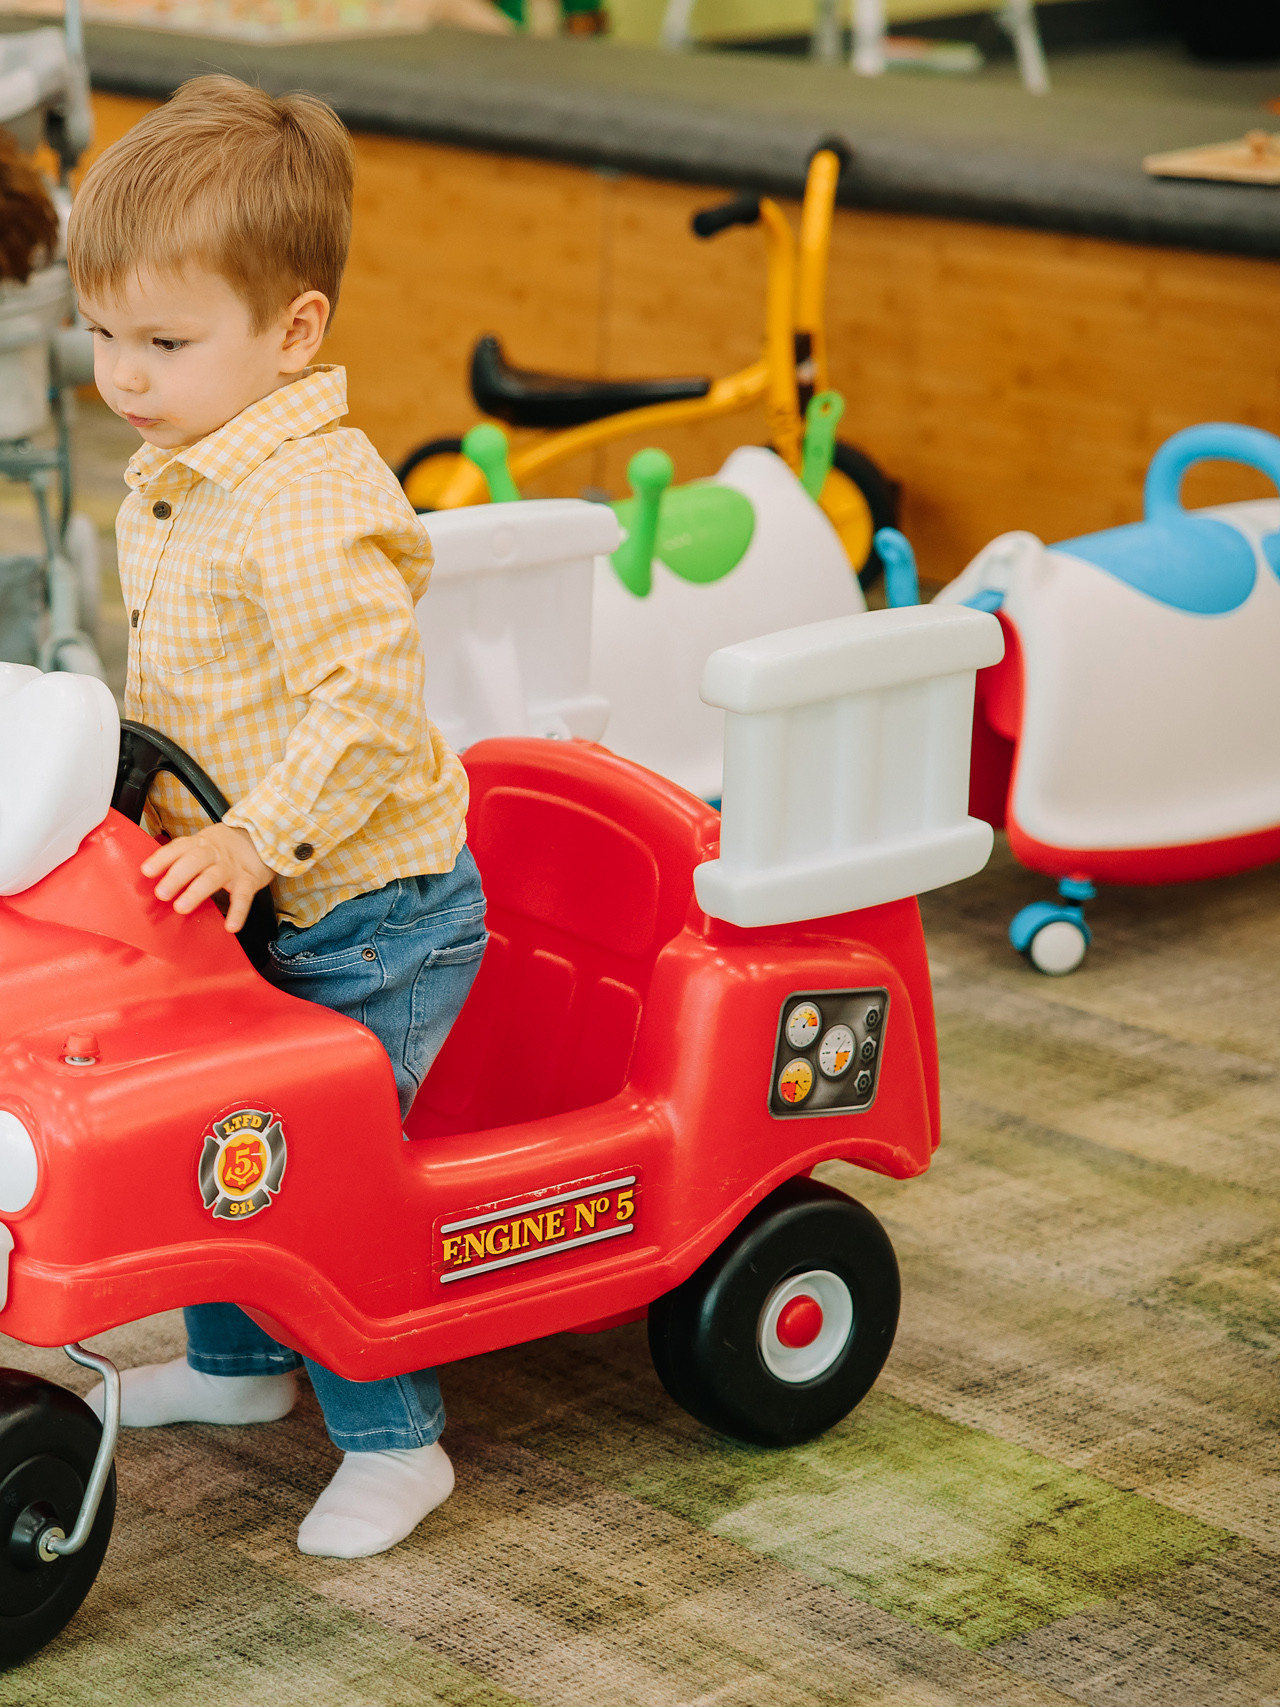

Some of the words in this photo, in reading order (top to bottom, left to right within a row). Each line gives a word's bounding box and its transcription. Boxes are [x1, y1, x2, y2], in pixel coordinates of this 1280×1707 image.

[223, 1114, 262, 1135] LTFD
[234, 1147, 252, 1175] 5
[229, 1199, 255, 1215] 911
[442, 1208, 565, 1265] ENGINE
[616, 1189, 635, 1220] 5
